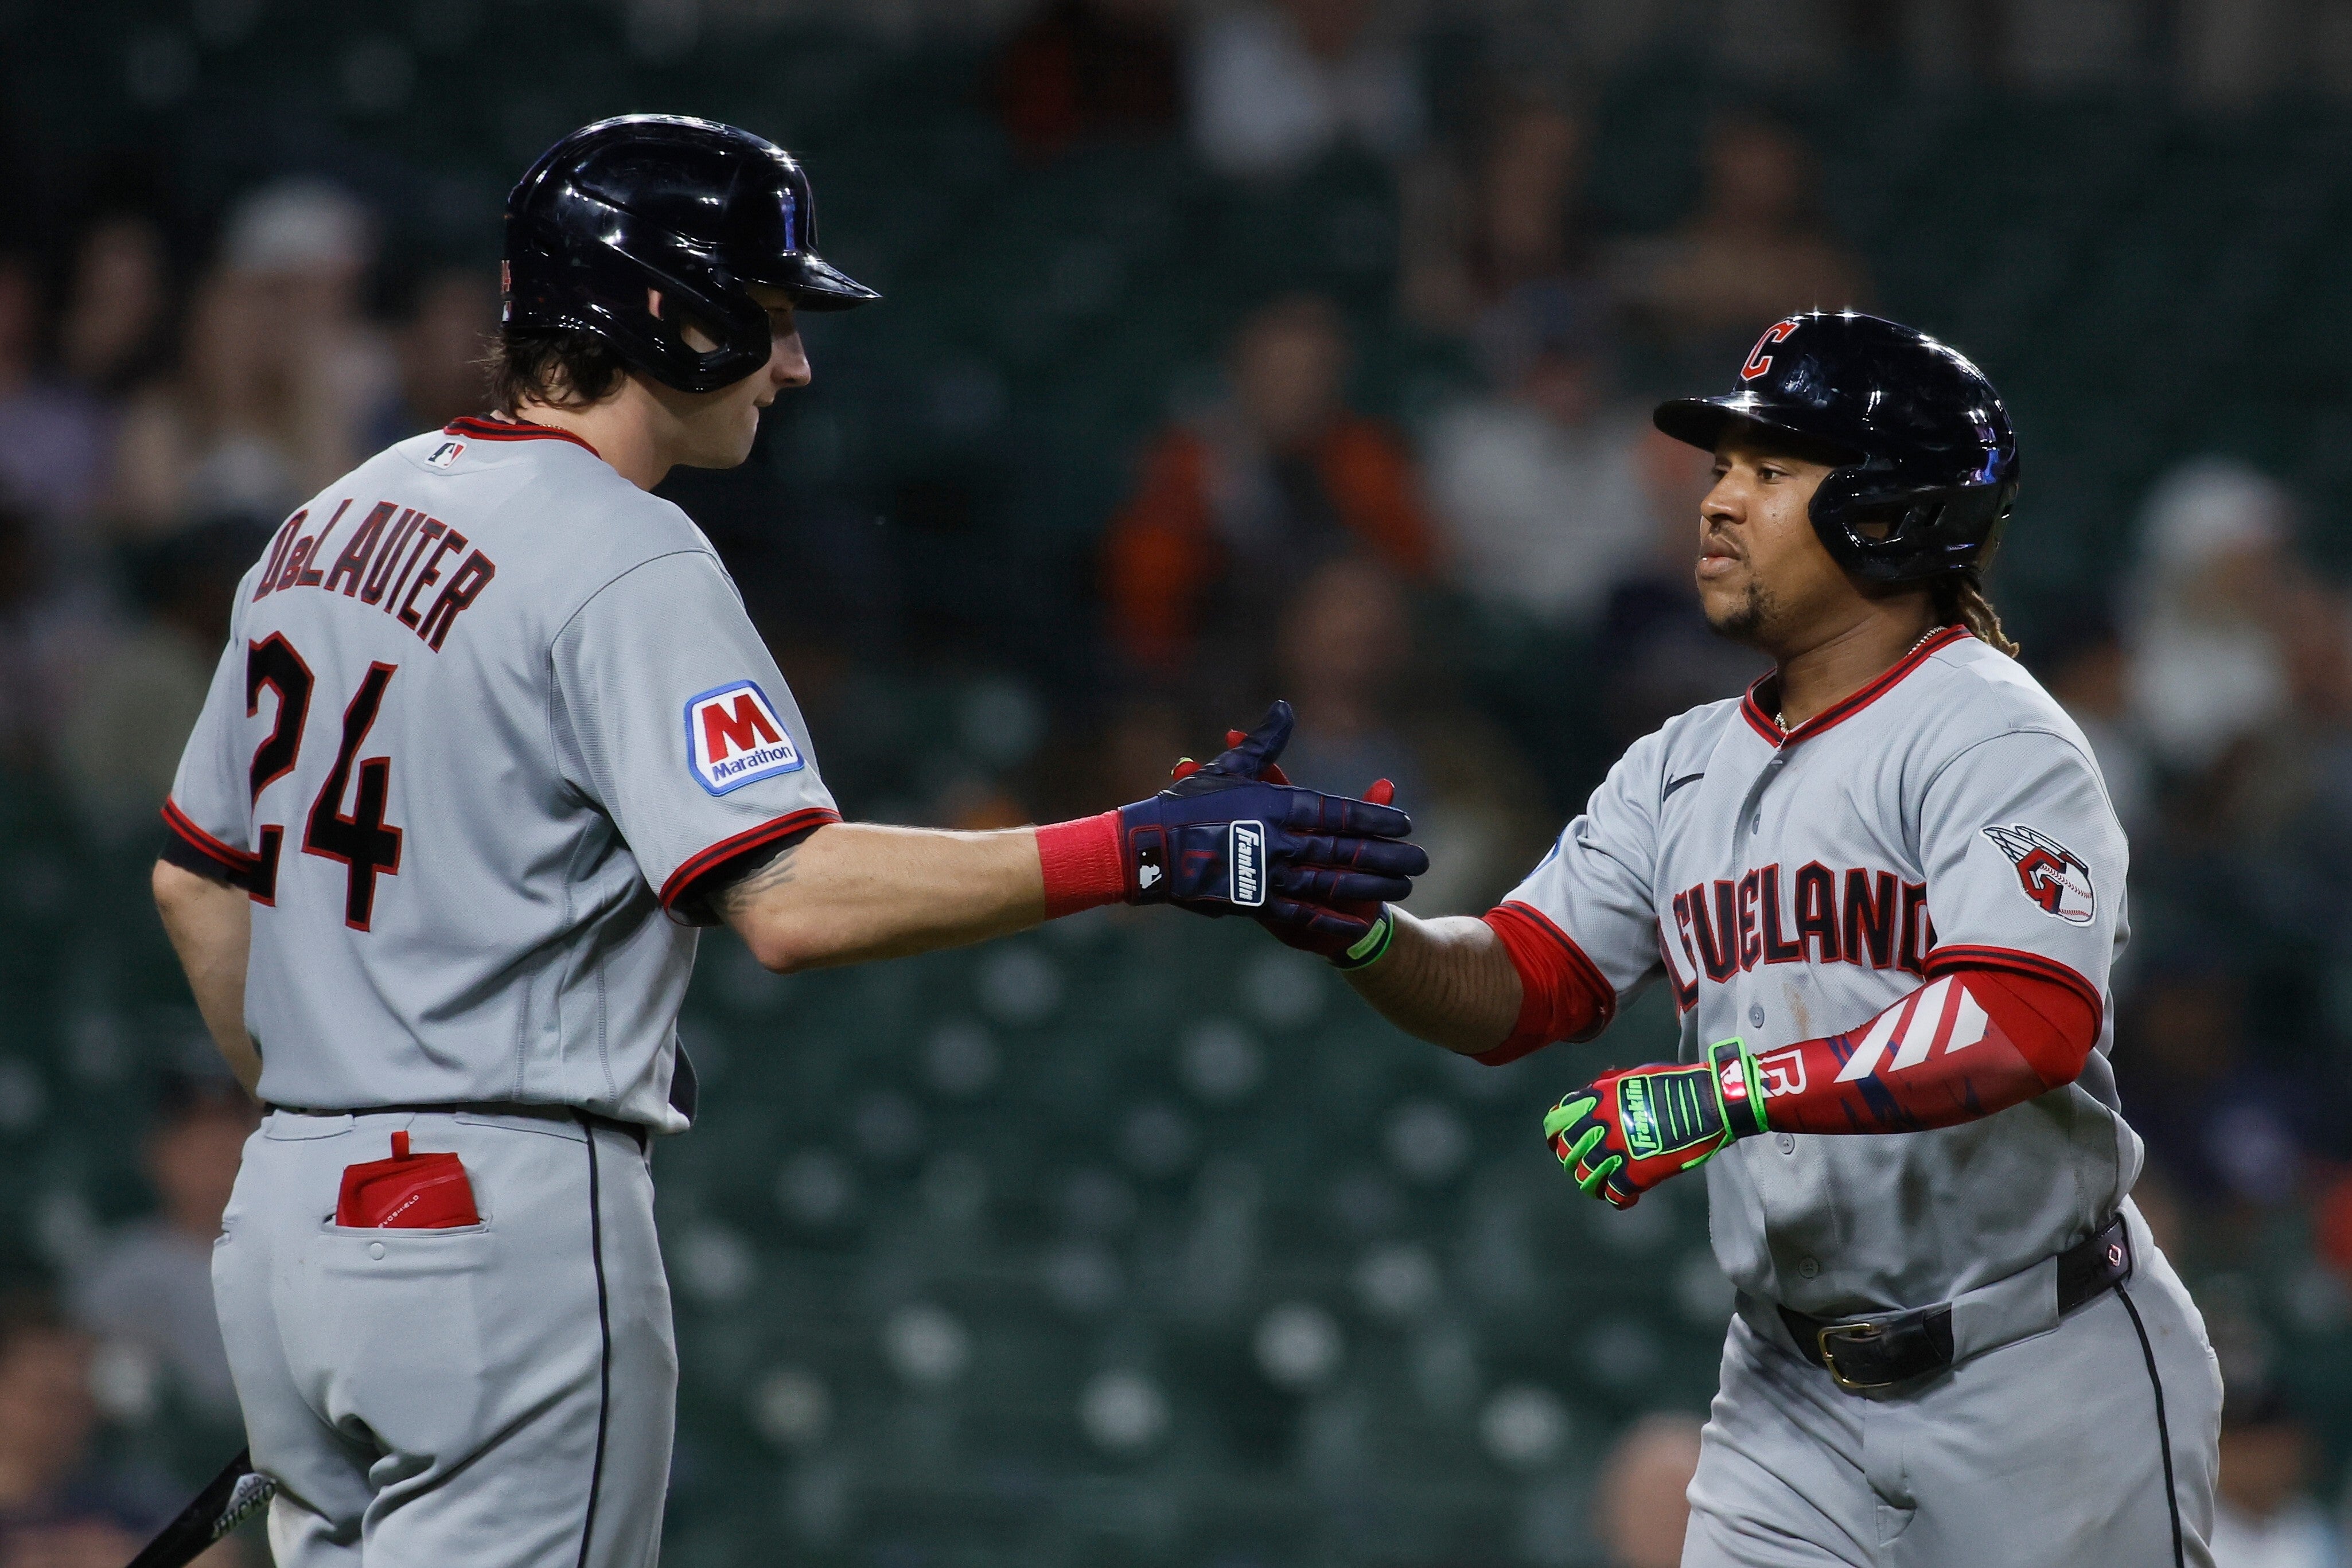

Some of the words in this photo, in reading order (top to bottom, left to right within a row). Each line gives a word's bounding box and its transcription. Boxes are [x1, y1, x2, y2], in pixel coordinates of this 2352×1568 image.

[1740, 319, 1801, 381] C
[702, 693, 782, 764] M
[711, 746, 793, 782] Marathon
[247, 630, 403, 933] 24
[1235, 826, 1260, 901] Franklin
[1657, 860, 1938, 1014] LEVELAND
[1626, 1079, 1658, 1149] Franklin
